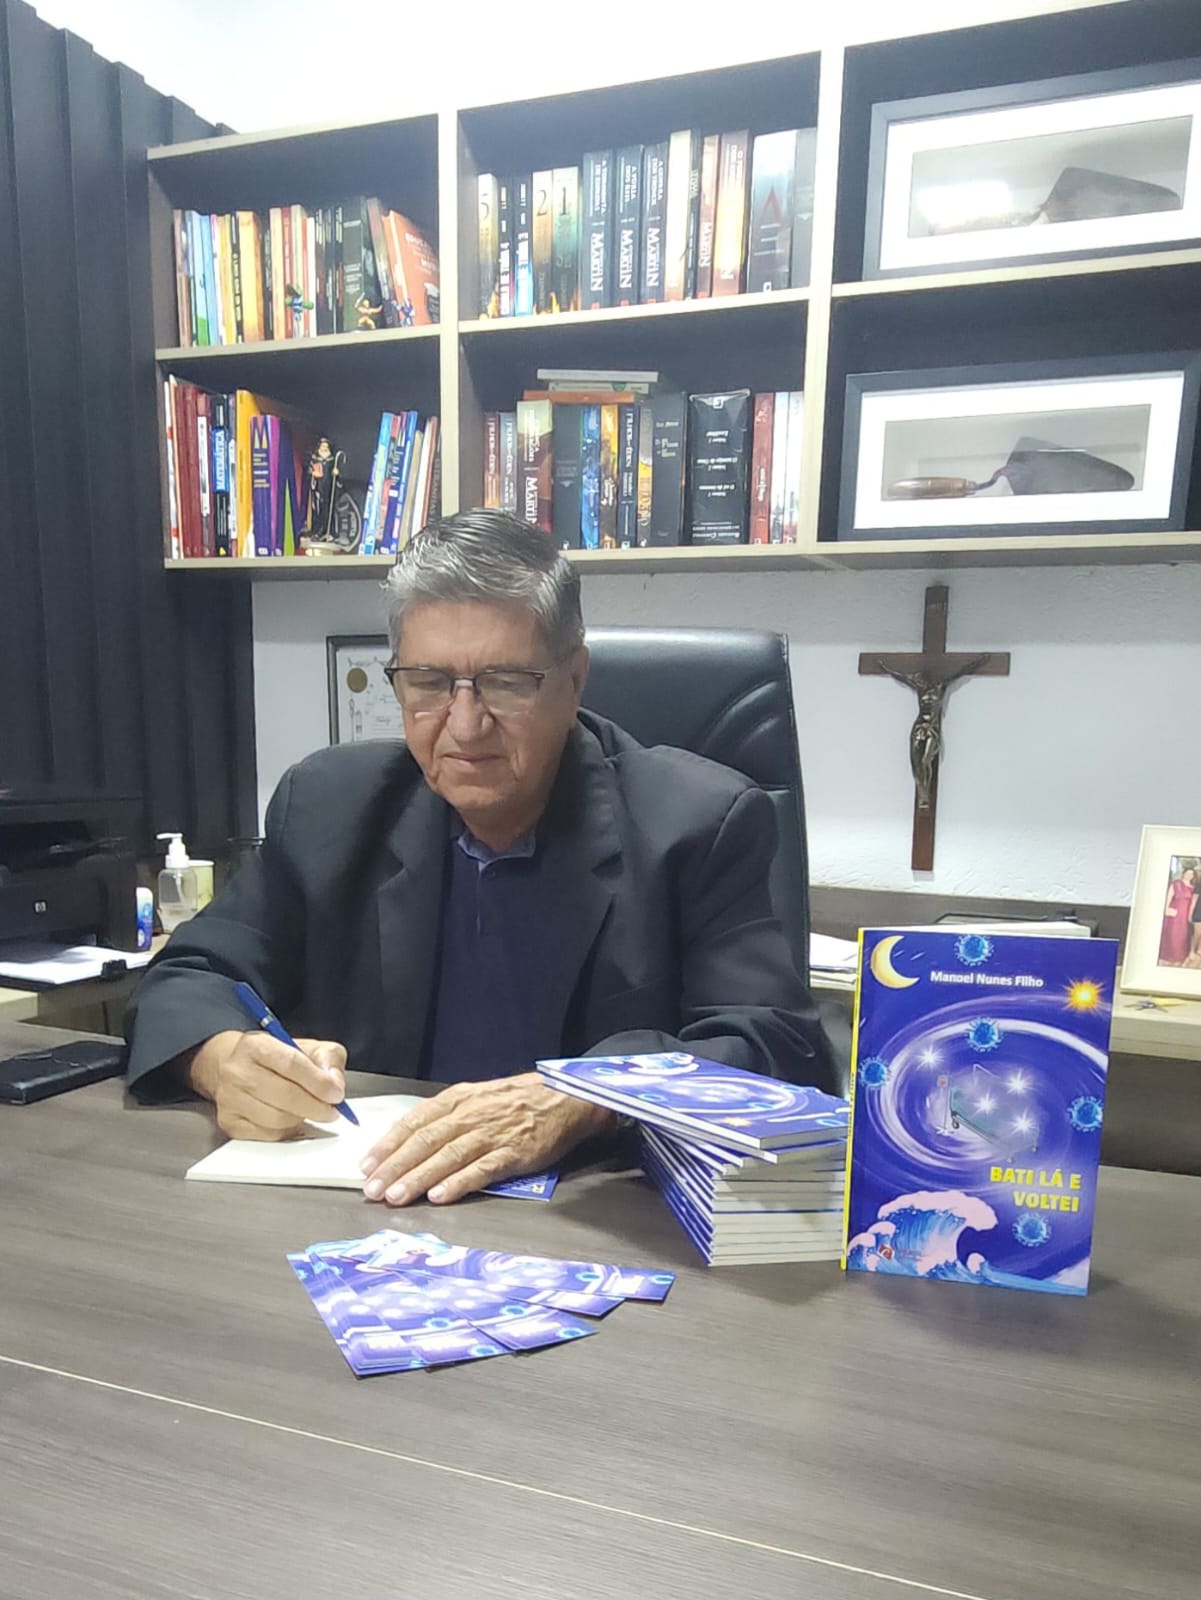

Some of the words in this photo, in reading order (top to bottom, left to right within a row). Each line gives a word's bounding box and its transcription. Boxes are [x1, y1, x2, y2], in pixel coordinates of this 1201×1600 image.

[590, 231, 604, 291] MARTIN
[620, 229, 633, 288] MARTIN
[646, 227, 660, 287] MARTIN
[930, 970, 974, 984] Manoel
[976, 973, 1012, 986] Nunes
[1015, 975, 1044, 987] Filho
[991, 1166, 1034, 1185] BATI
[1039, 1168, 1064, 1188] LÁ
[1069, 1173, 1081, 1189] E
[1013, 1191, 1080, 1212] VOLTEI
